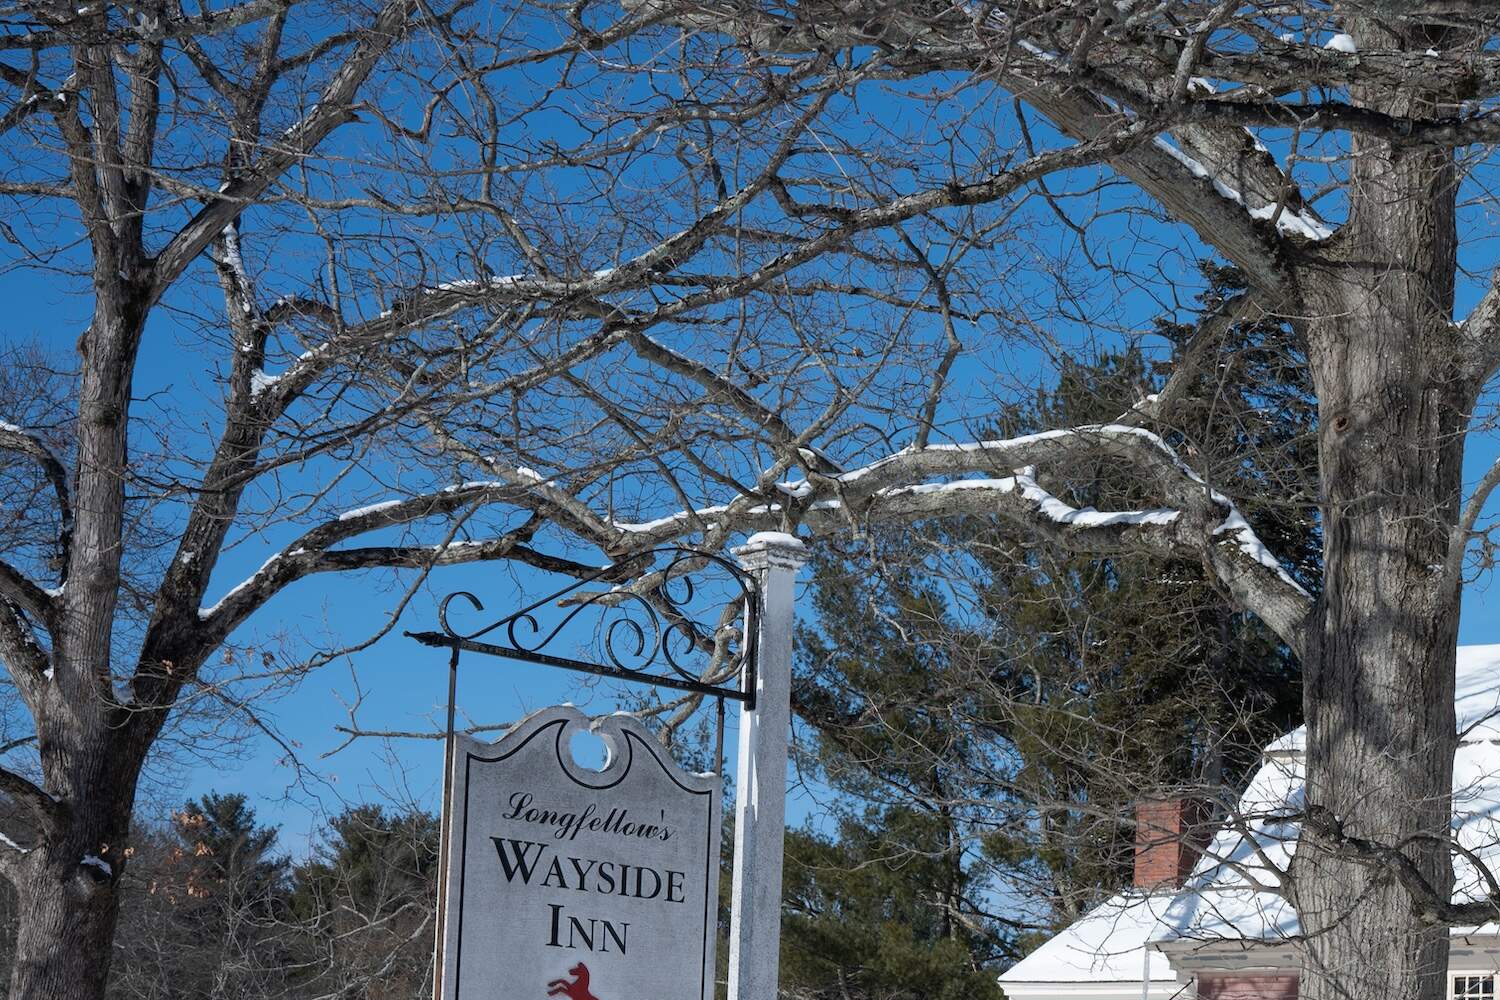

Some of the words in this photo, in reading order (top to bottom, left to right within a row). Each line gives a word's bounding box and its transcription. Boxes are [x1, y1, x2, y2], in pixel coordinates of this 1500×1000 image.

[502, 791, 677, 841] Longfellow's
[489, 836, 686, 903] WAYSIDE
[545, 903, 631, 955] INN
